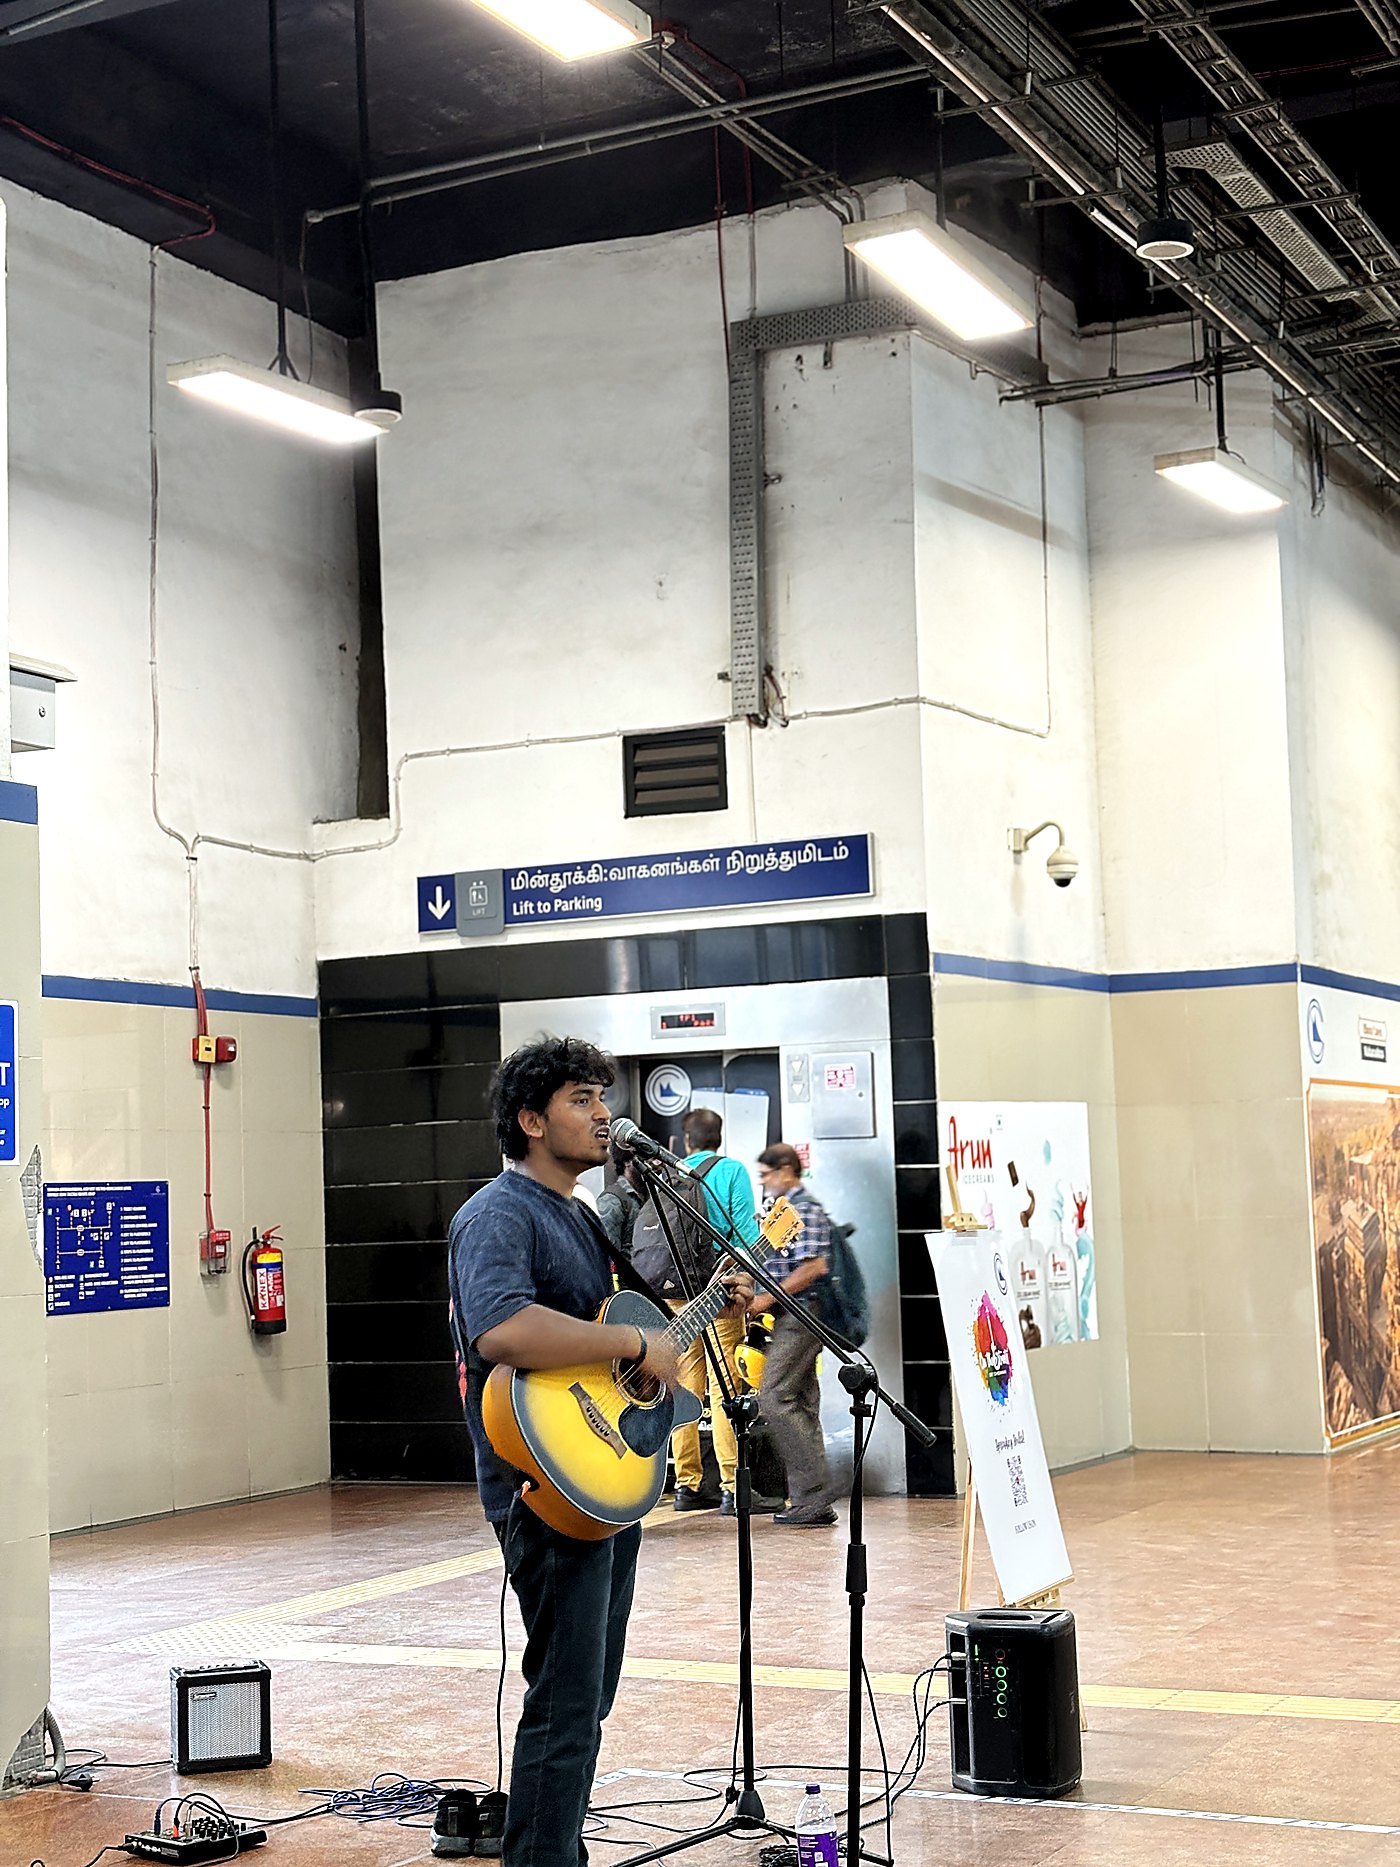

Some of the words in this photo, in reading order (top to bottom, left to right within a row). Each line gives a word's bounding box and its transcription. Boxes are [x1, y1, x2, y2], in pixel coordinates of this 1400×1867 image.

[726, 840, 849, 876] நிறுத்துமிடம்
[512, 900, 535, 916] Lift
[537, 902, 551, 915] to
[554, 896, 603, 912] Parking
[947, 1116, 993, 1182] Arun
